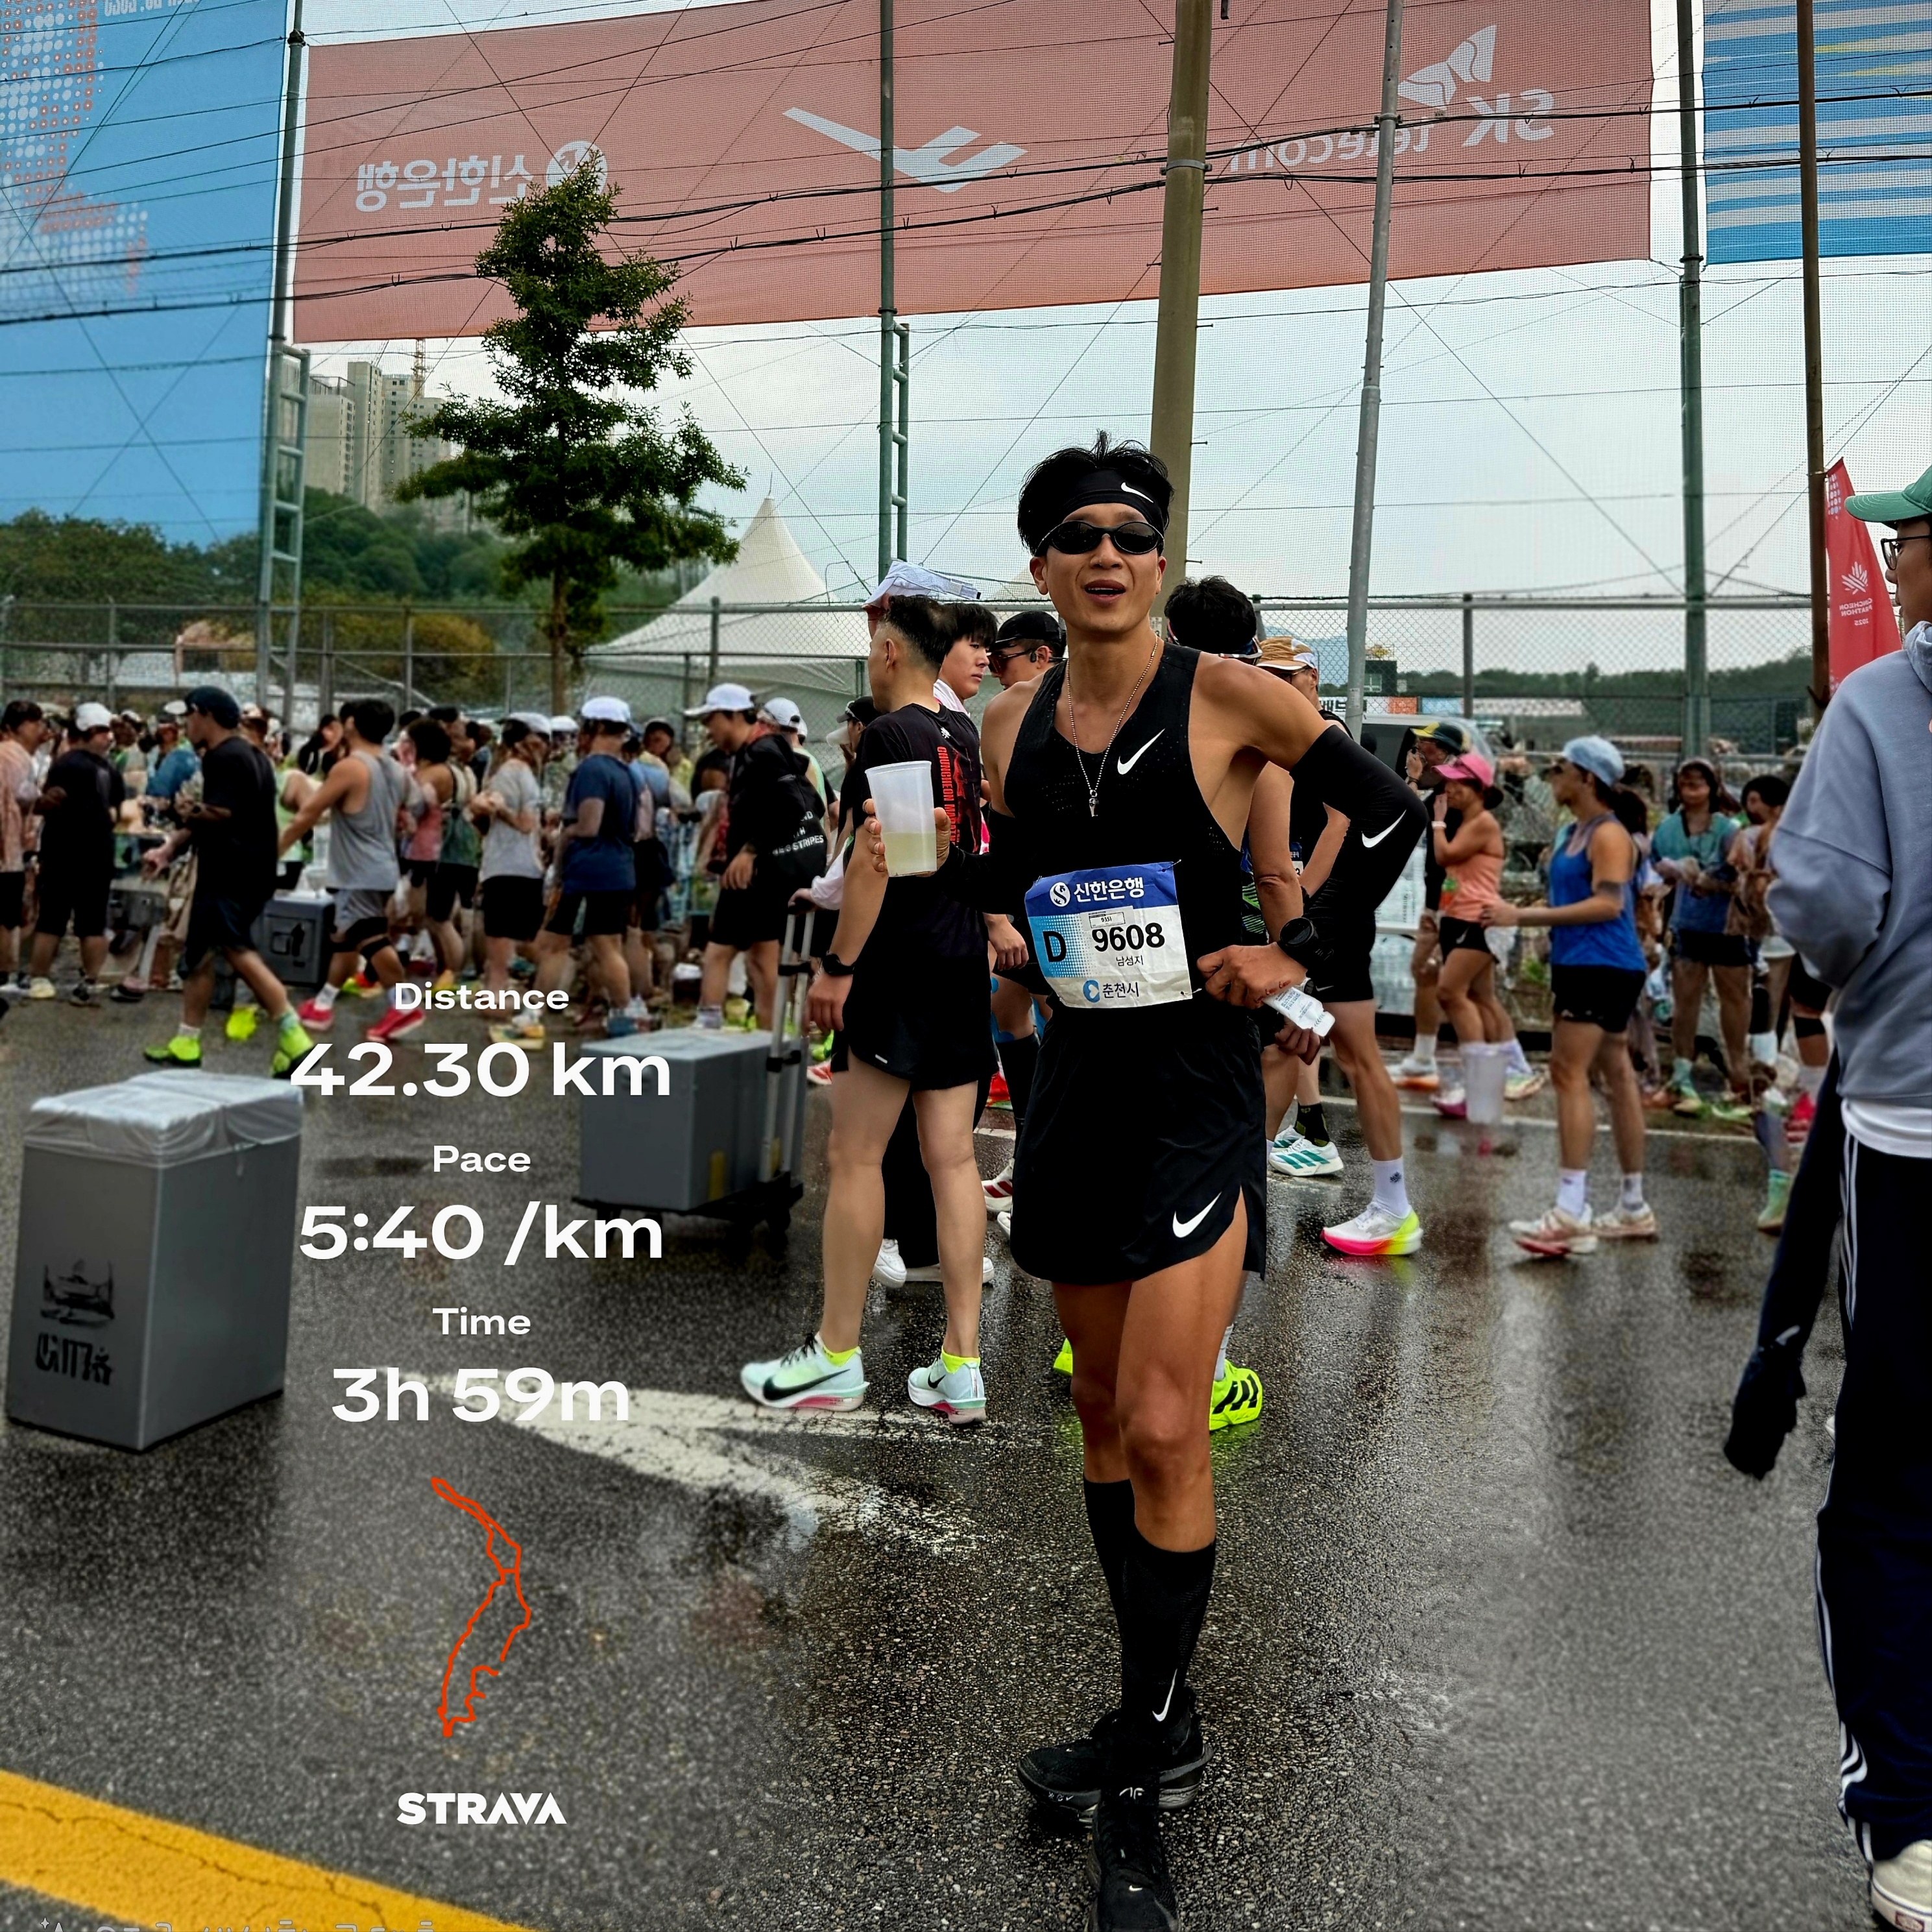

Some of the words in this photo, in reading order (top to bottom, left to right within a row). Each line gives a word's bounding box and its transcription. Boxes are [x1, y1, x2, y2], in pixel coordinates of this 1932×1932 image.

[792, 834, 824, 851] STRIPES
[1074, 876, 1144, 902] 신한은행
[1043, 930, 1067, 963] D
[1092, 922, 1165, 952] 9608
[1116, 954, 1144, 967] 남성지
[1102, 982, 1139, 998] 춘천시
